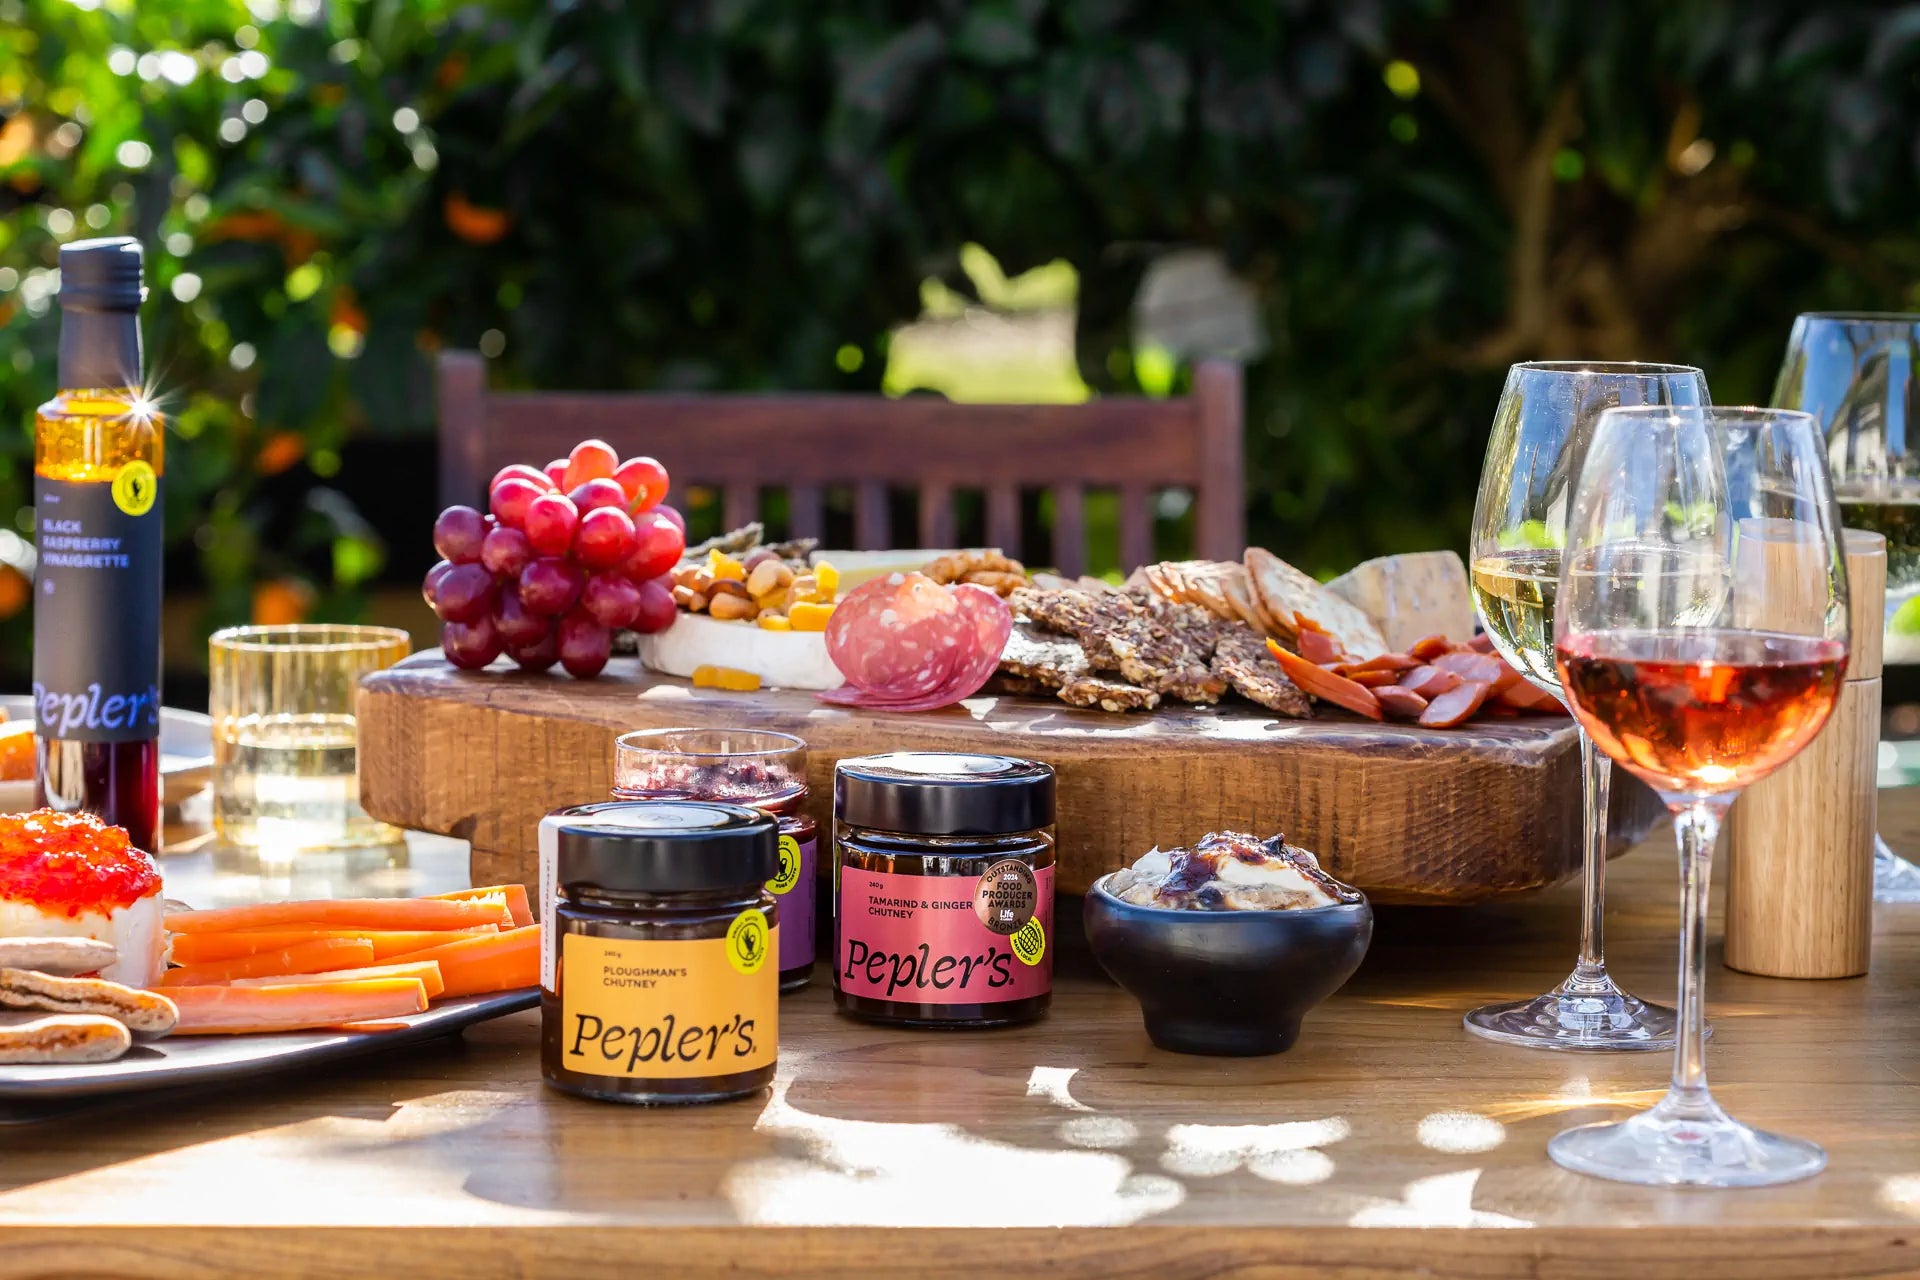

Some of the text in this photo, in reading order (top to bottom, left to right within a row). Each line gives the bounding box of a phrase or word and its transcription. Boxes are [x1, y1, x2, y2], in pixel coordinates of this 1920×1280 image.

[42, 518, 82, 534] BLACK
[42, 535, 122, 551] RASPBERRY
[42, 552, 130, 568] VINAIGRETTE
[986, 864, 1033, 885] OUTSTANDING
[996, 882, 1022, 890] FOOD
[982, 890, 1033, 900] PRODUCER
[868, 895, 973, 910] TAMARIND & GINGER
[988, 900, 1026, 909] AWARDS
[868, 906, 914, 919] CHUTNEY
[999, 909, 1014, 919] Life
[988, 916, 1024, 931] BRONZE
[603, 966, 688, 978] PLOUGHMAN'S
[603, 977, 657, 989] CHUTNEY
